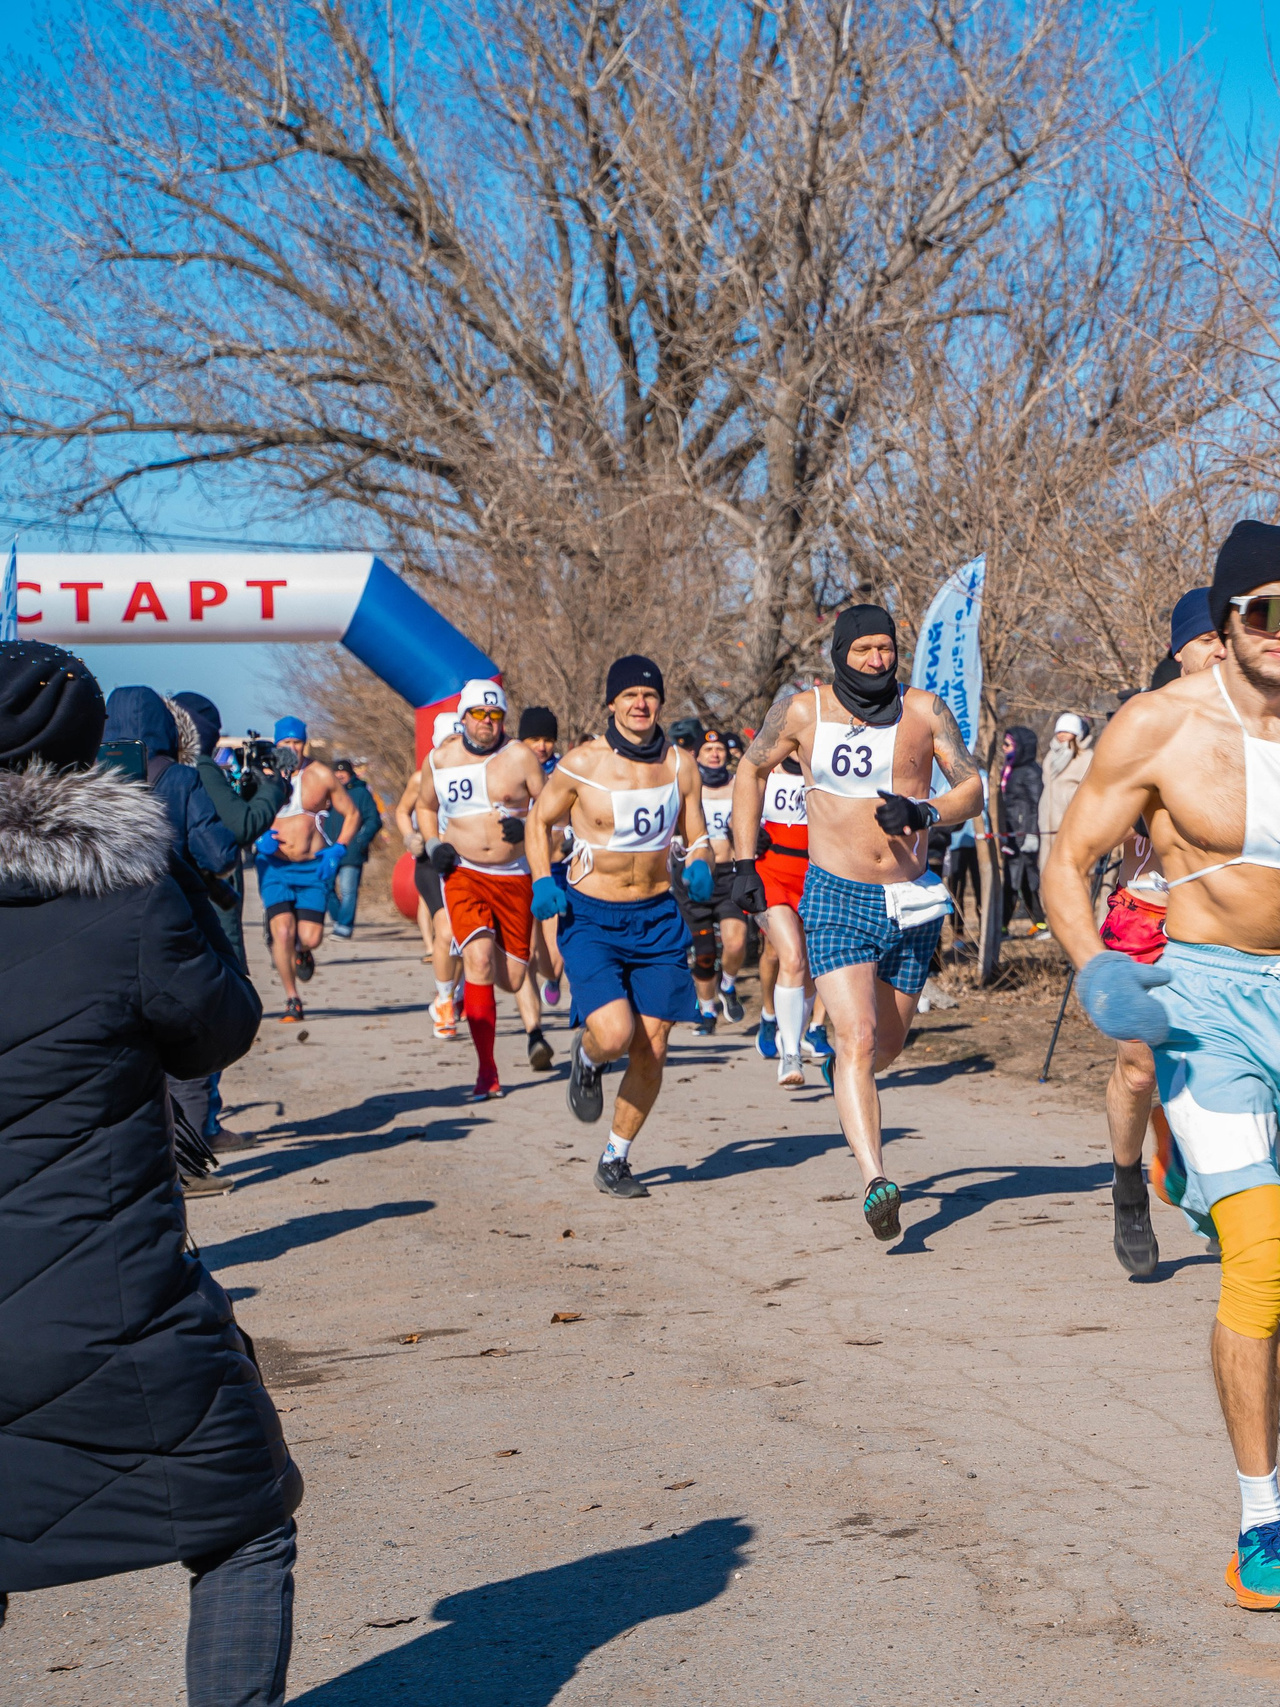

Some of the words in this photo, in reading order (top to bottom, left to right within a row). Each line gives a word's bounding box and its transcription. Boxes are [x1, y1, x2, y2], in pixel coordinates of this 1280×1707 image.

[16, 580, 287, 623] СТАРТ
[831, 743, 872, 777] 63
[448, 778, 473, 802] 59
[633, 807, 666, 837] 61
